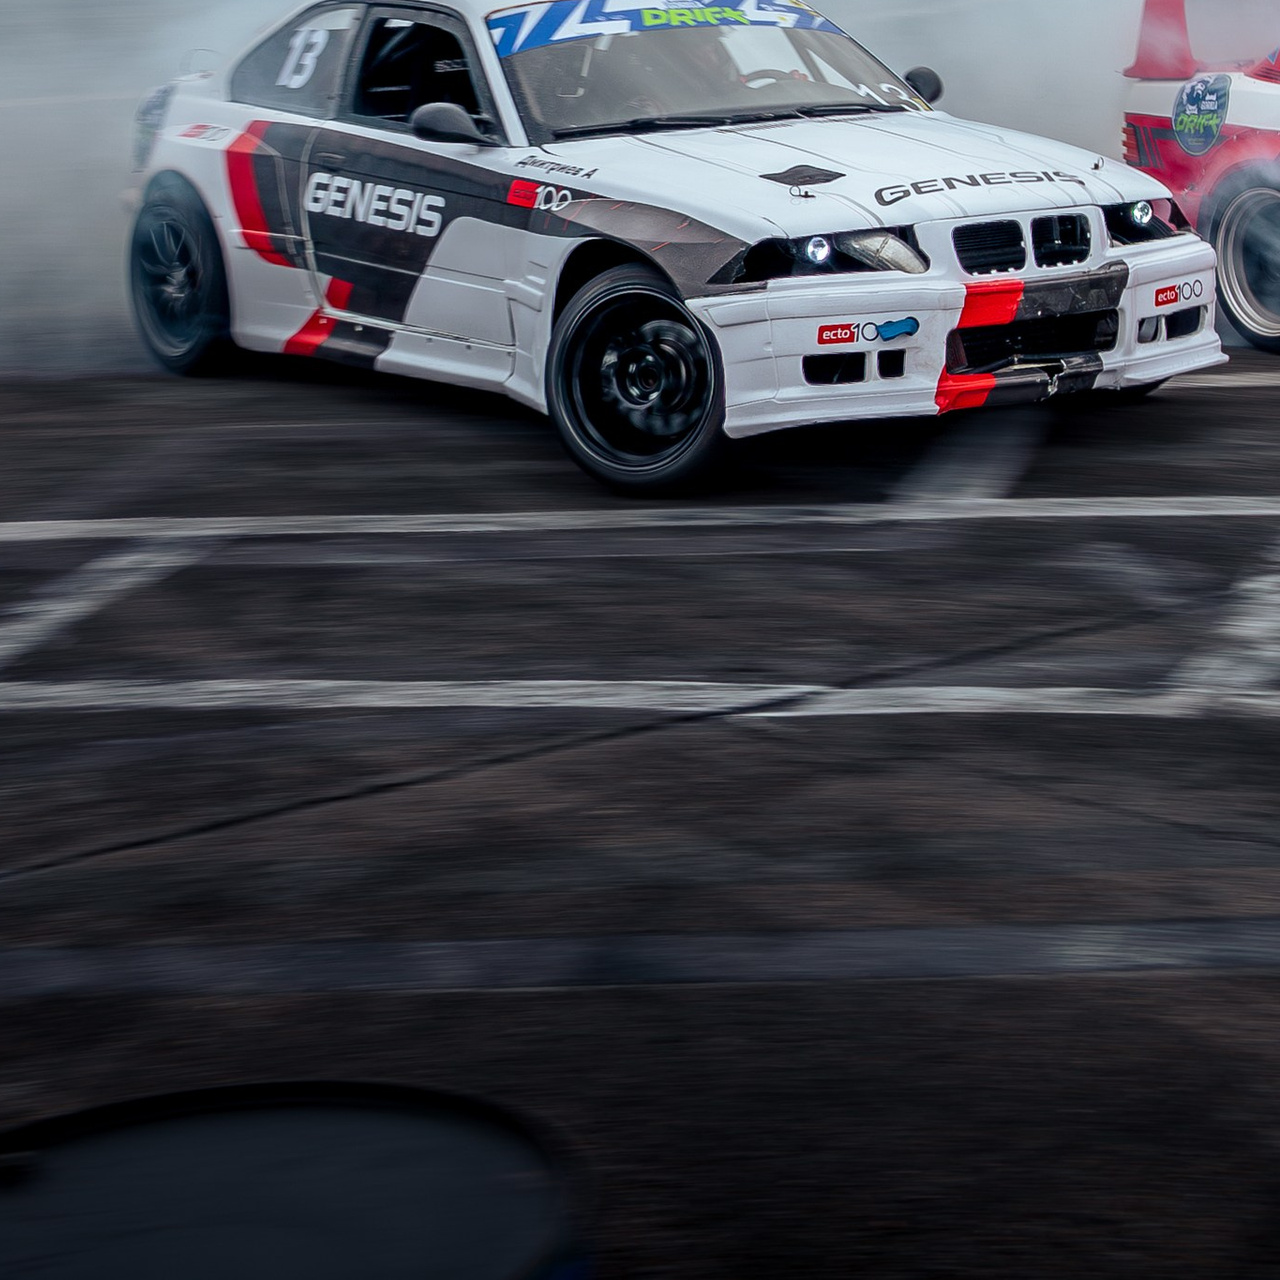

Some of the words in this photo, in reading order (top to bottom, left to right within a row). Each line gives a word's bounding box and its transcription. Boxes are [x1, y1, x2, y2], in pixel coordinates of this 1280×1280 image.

[640, 6, 751, 27] DRIFT
[275, 29, 331, 89] 13
[858, 83, 925, 112] 13
[303, 171, 446, 238] GENESIS
[873, 170, 1086, 207] GENESIS
[1157, 279, 1203, 303] ecto100
